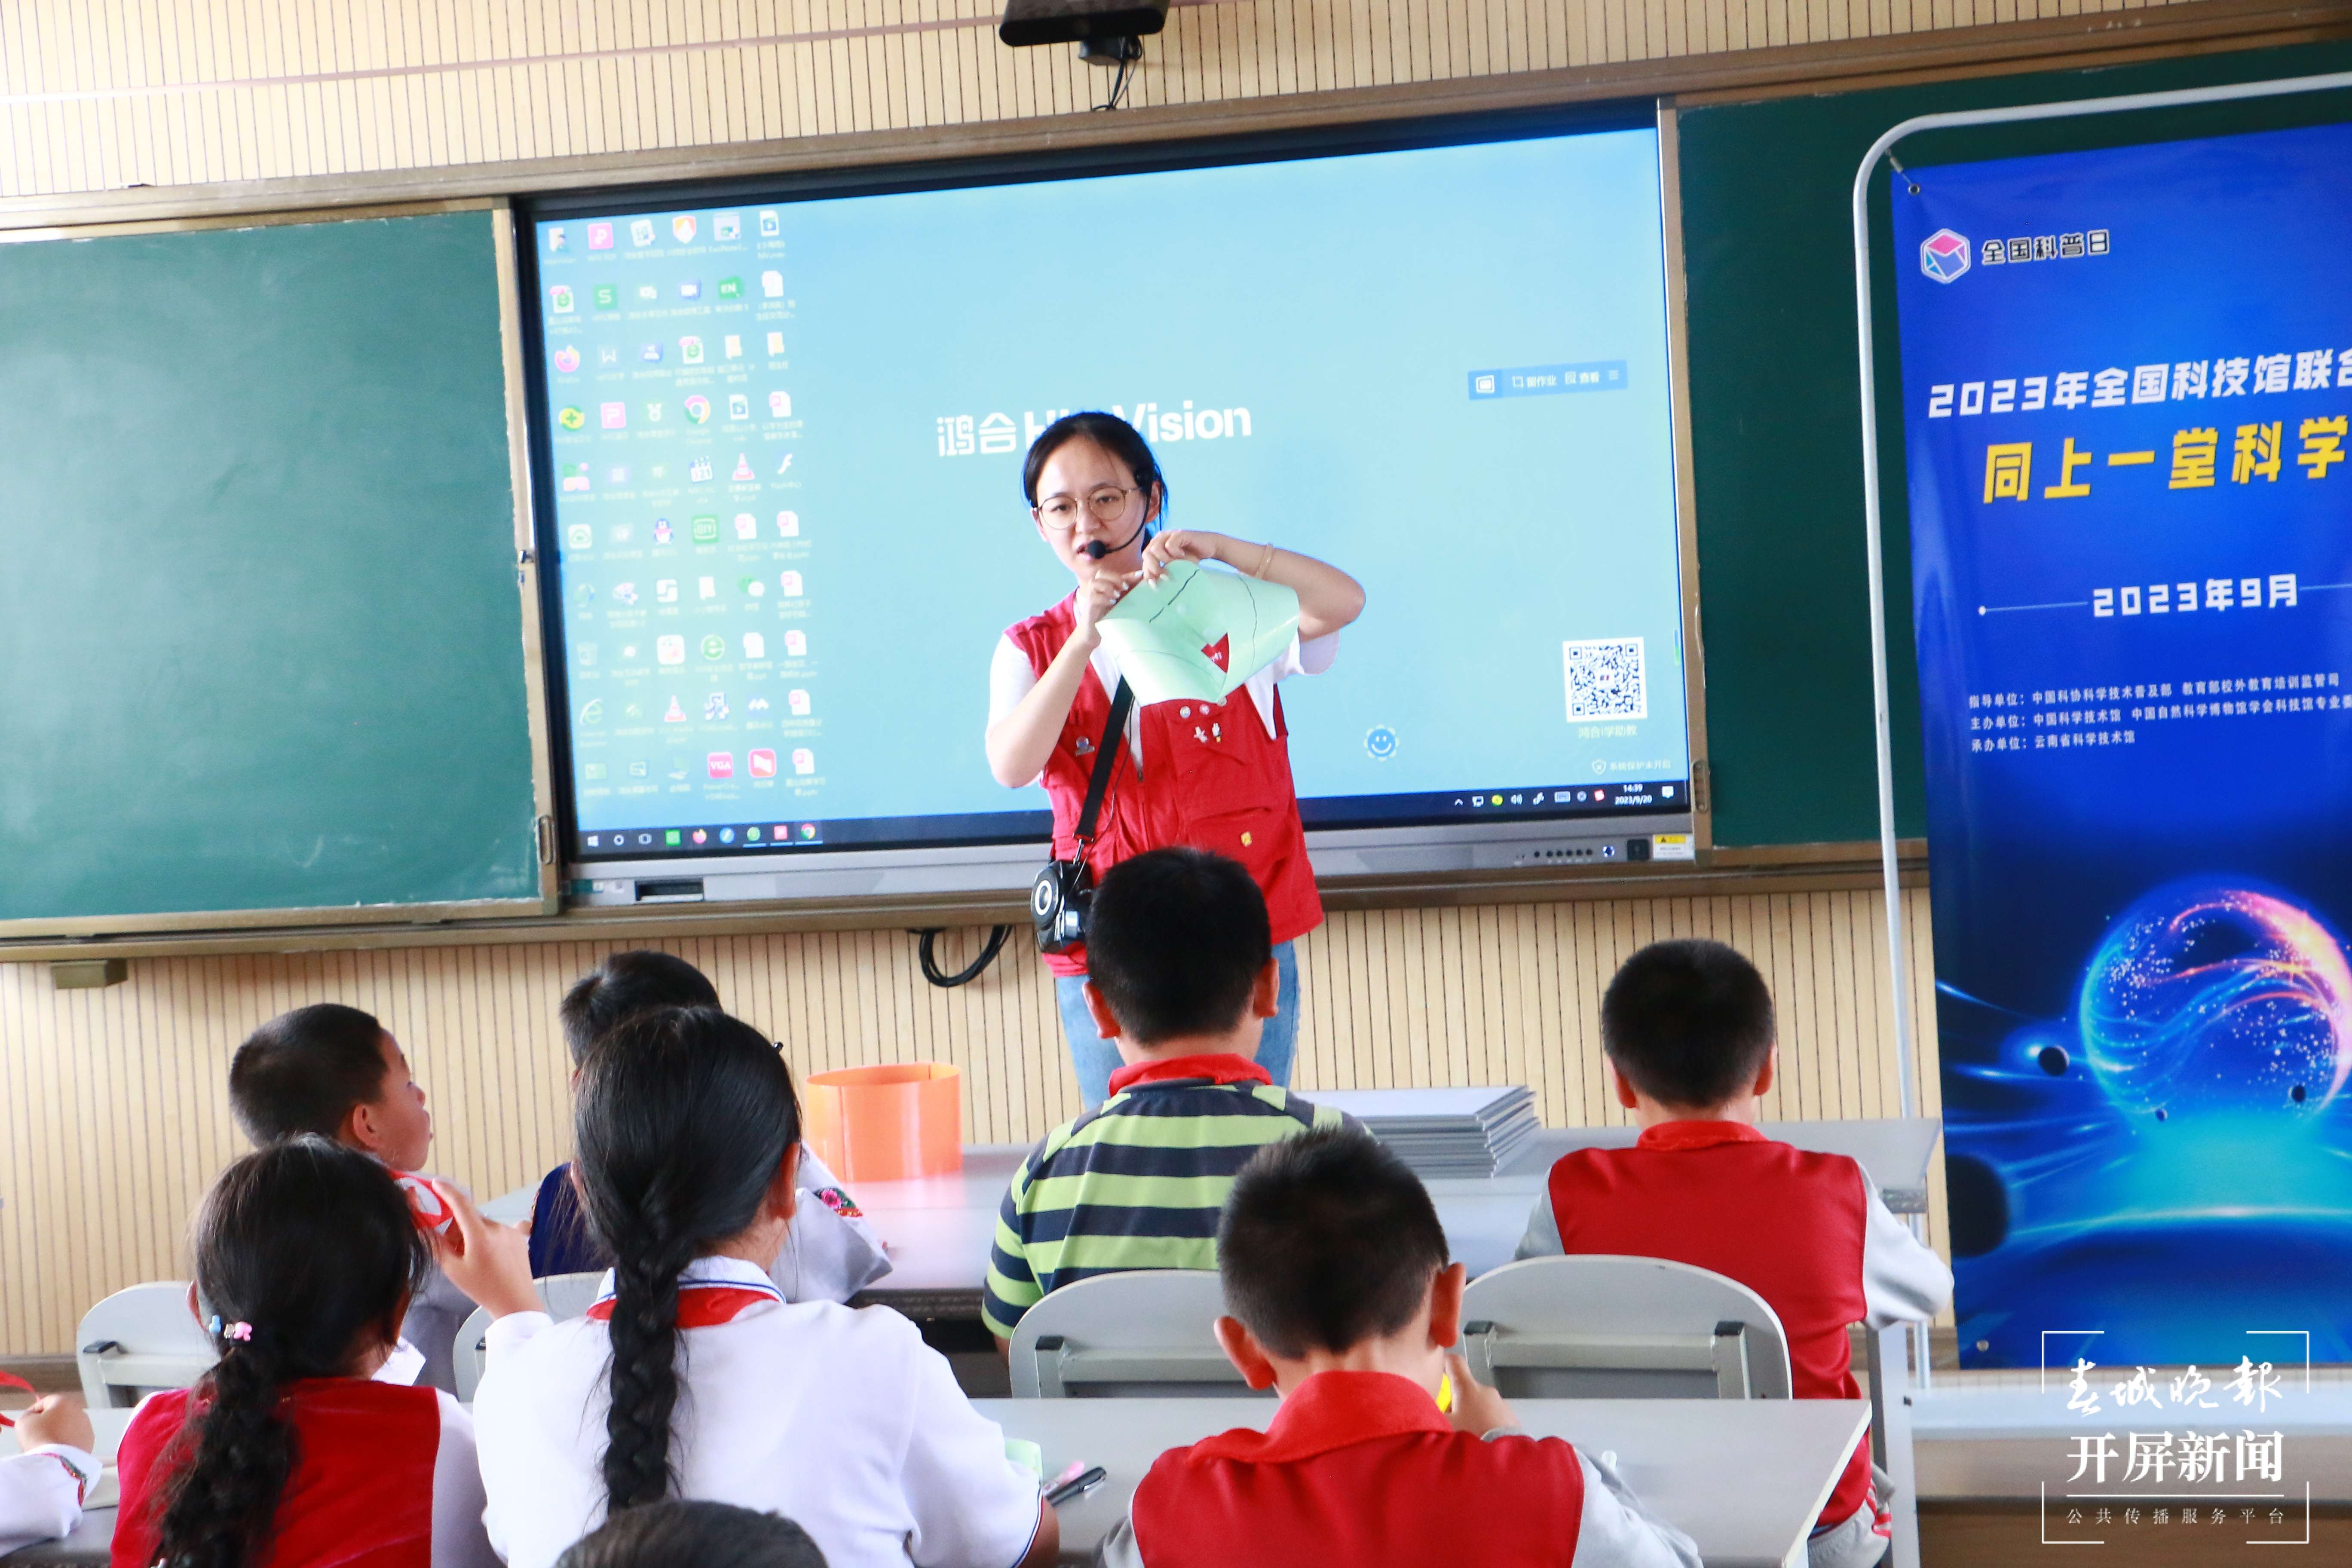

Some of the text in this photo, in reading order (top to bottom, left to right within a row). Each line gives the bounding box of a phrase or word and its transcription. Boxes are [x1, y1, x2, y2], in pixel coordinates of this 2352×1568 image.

[1981, 229, 2110, 266] 全国科普日
[937, 412, 1016, 456] 鸿合
[1984, 416, 2349, 503] 同上一堂科学
[2093, 573, 2297, 617] 2023年9月
[710, 761, 732, 770] VGA
